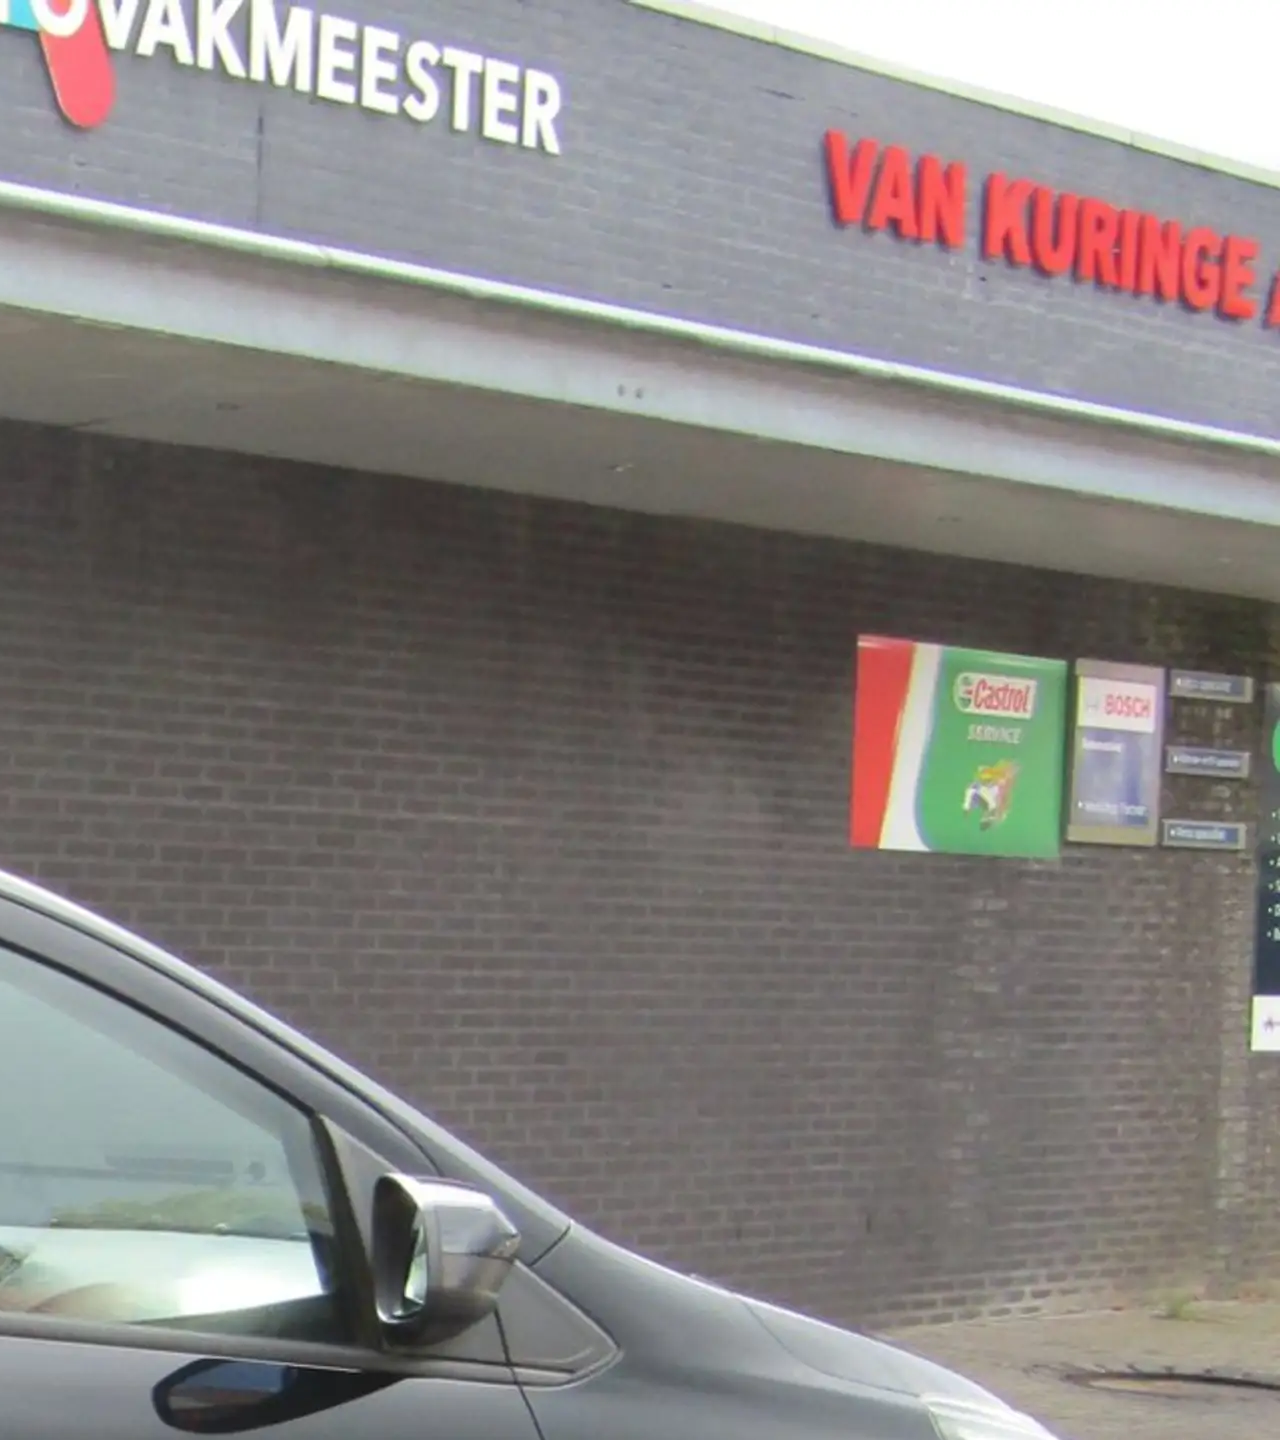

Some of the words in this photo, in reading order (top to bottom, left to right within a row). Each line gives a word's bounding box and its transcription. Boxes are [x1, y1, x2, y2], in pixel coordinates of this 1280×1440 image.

[824, 128, 966, 251] VAN
[983, 171, 1259, 320] KURINGE
[974, 678, 1032, 713] Castrol
[1104, 693, 1151, 719] BOSCH
